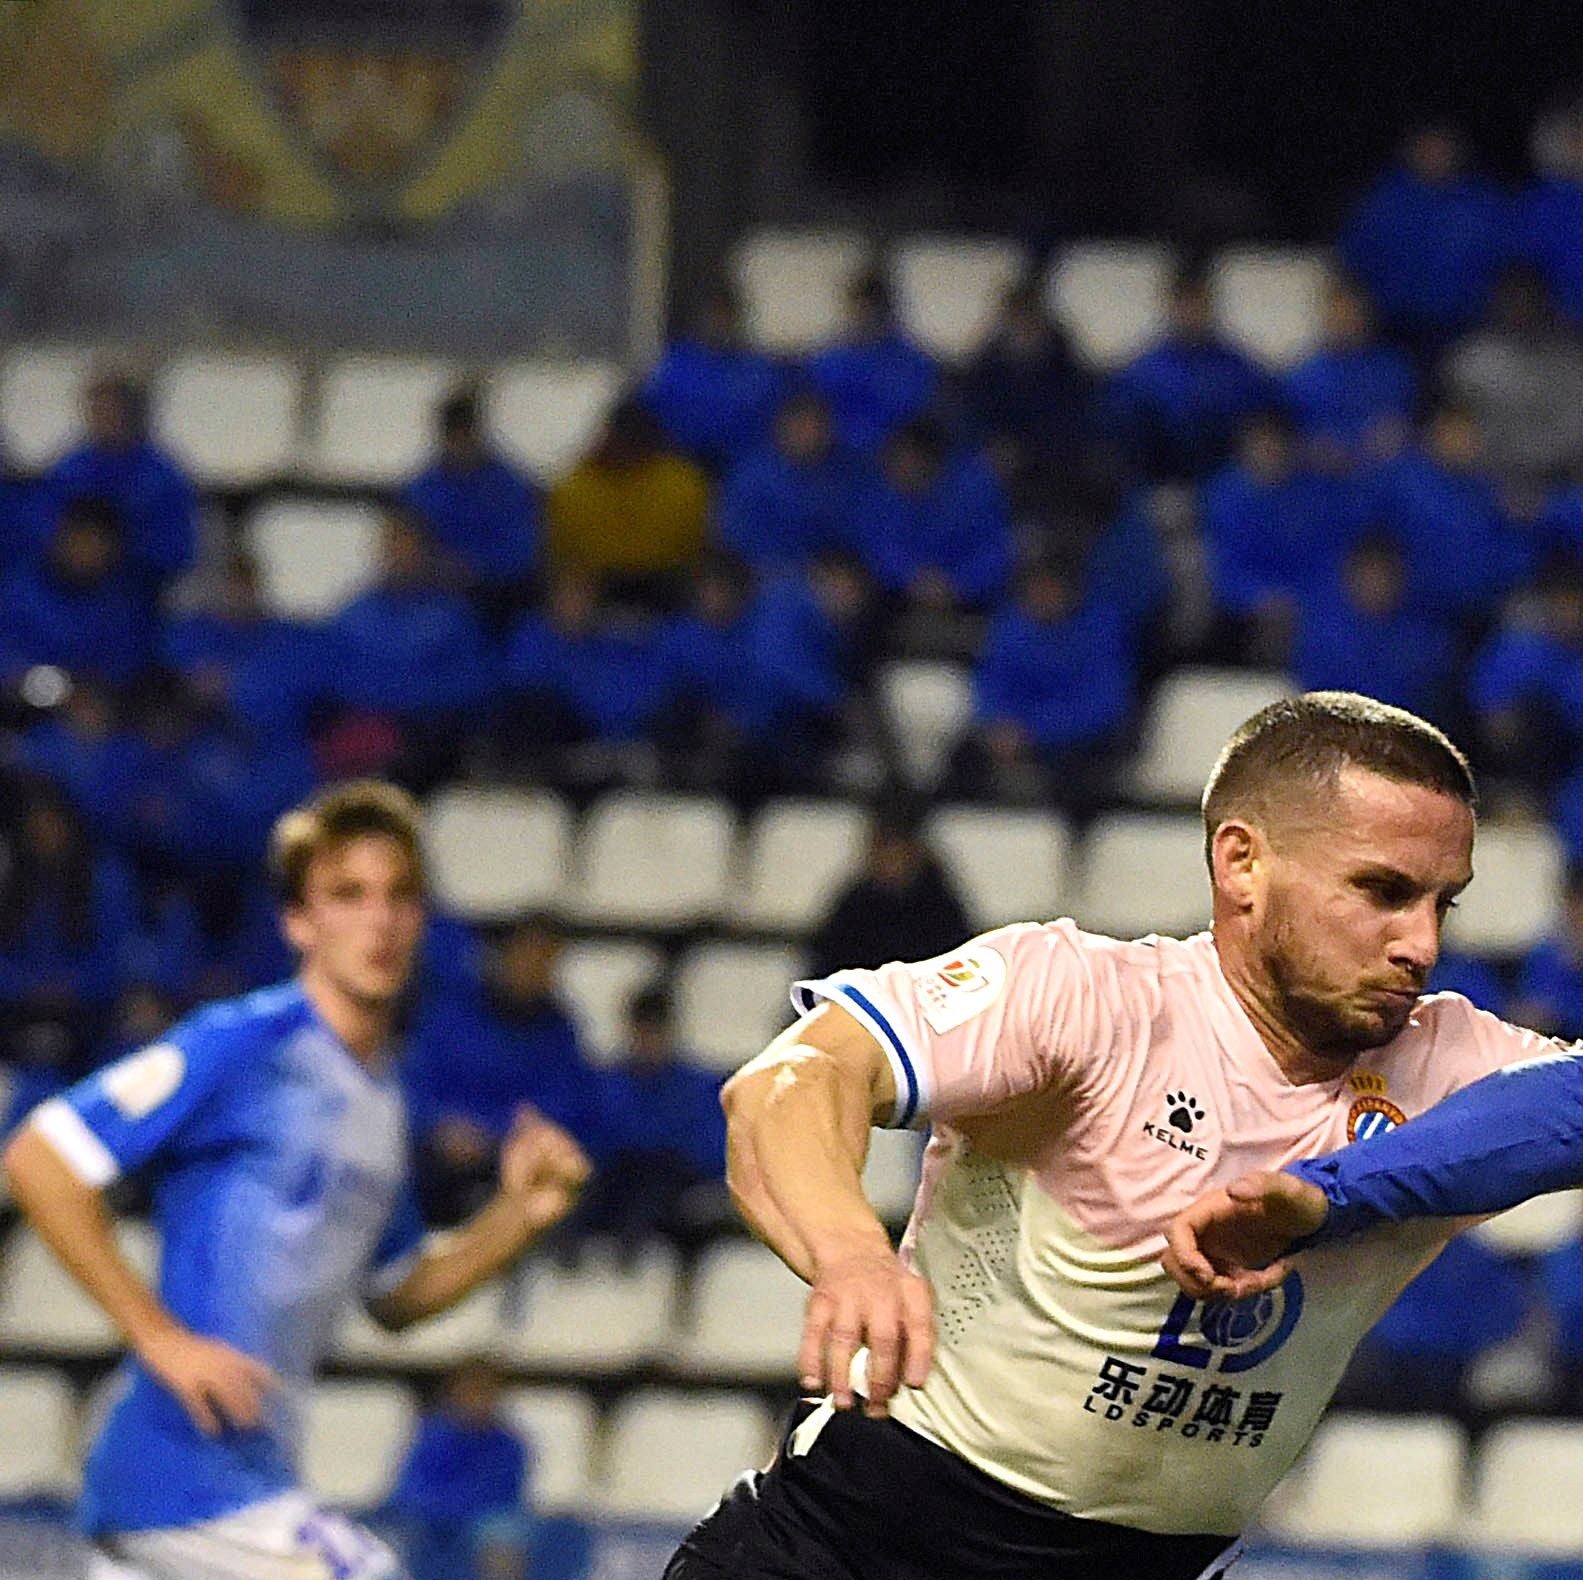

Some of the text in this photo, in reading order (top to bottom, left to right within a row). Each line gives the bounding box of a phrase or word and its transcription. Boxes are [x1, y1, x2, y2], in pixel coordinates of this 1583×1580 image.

[1143, 1121, 1208, 1161] KELME
[1092, 1356, 1283, 1431] 乐动体育
[1083, 1395, 1265, 1448] LDSPORTS
